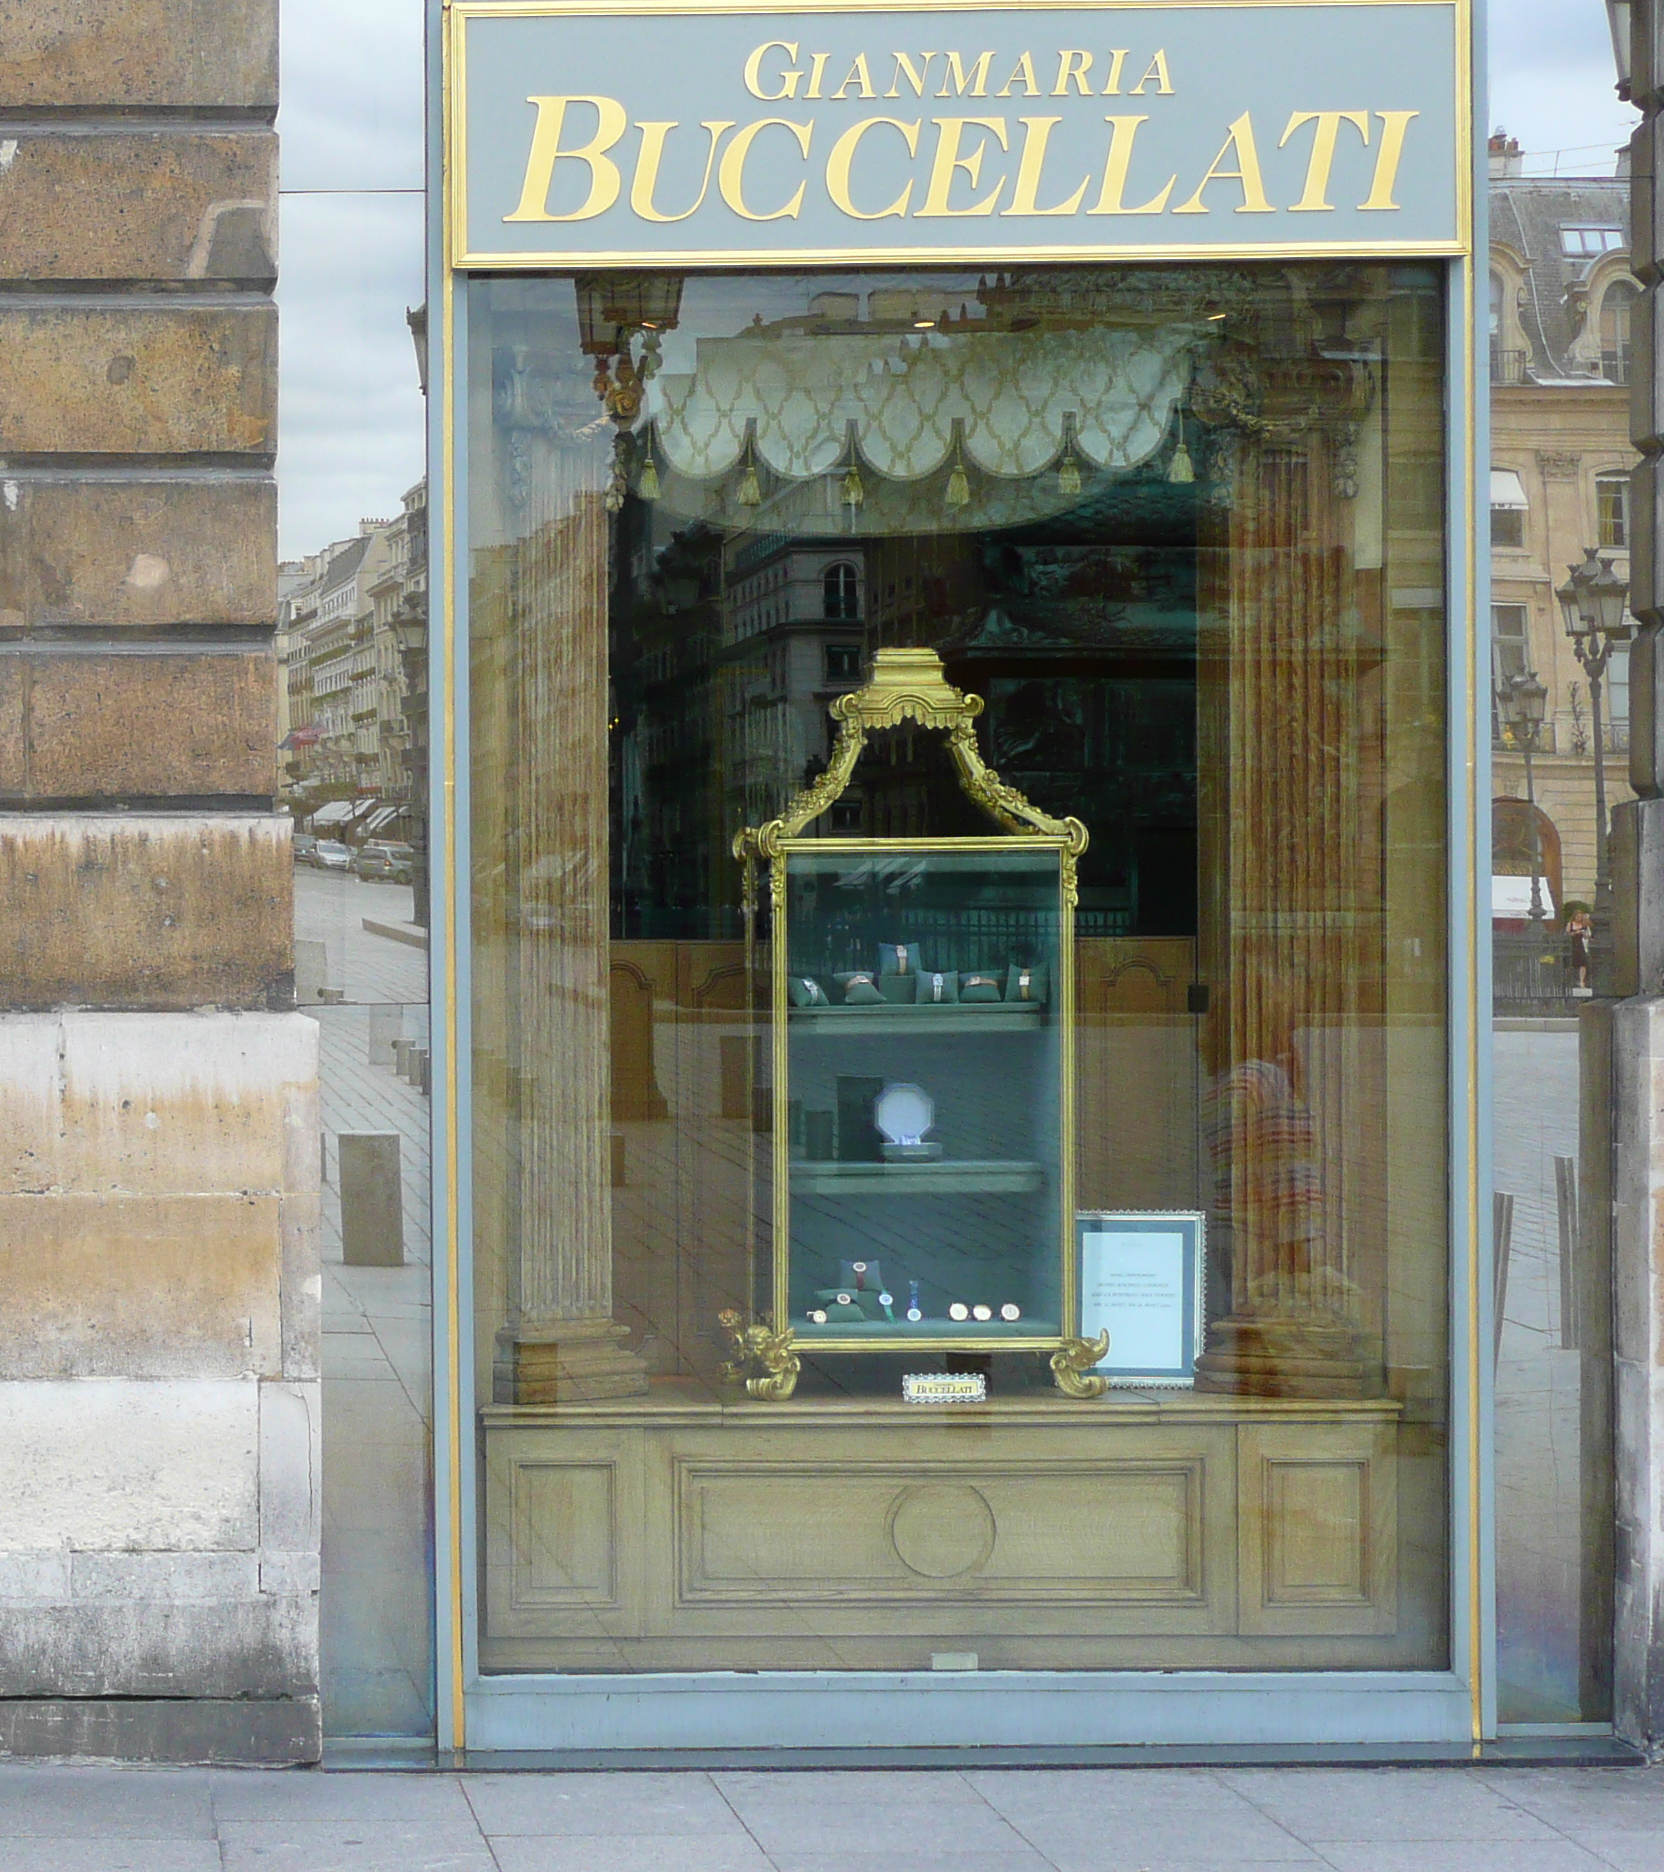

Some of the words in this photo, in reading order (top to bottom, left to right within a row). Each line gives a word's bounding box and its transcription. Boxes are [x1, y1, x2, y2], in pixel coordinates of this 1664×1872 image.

[743, 40, 1176, 101] GIANMARIA
[502, 94, 1420, 223] BUCCELLATI
[916, 1384, 973, 1394] BUCCELLATI
